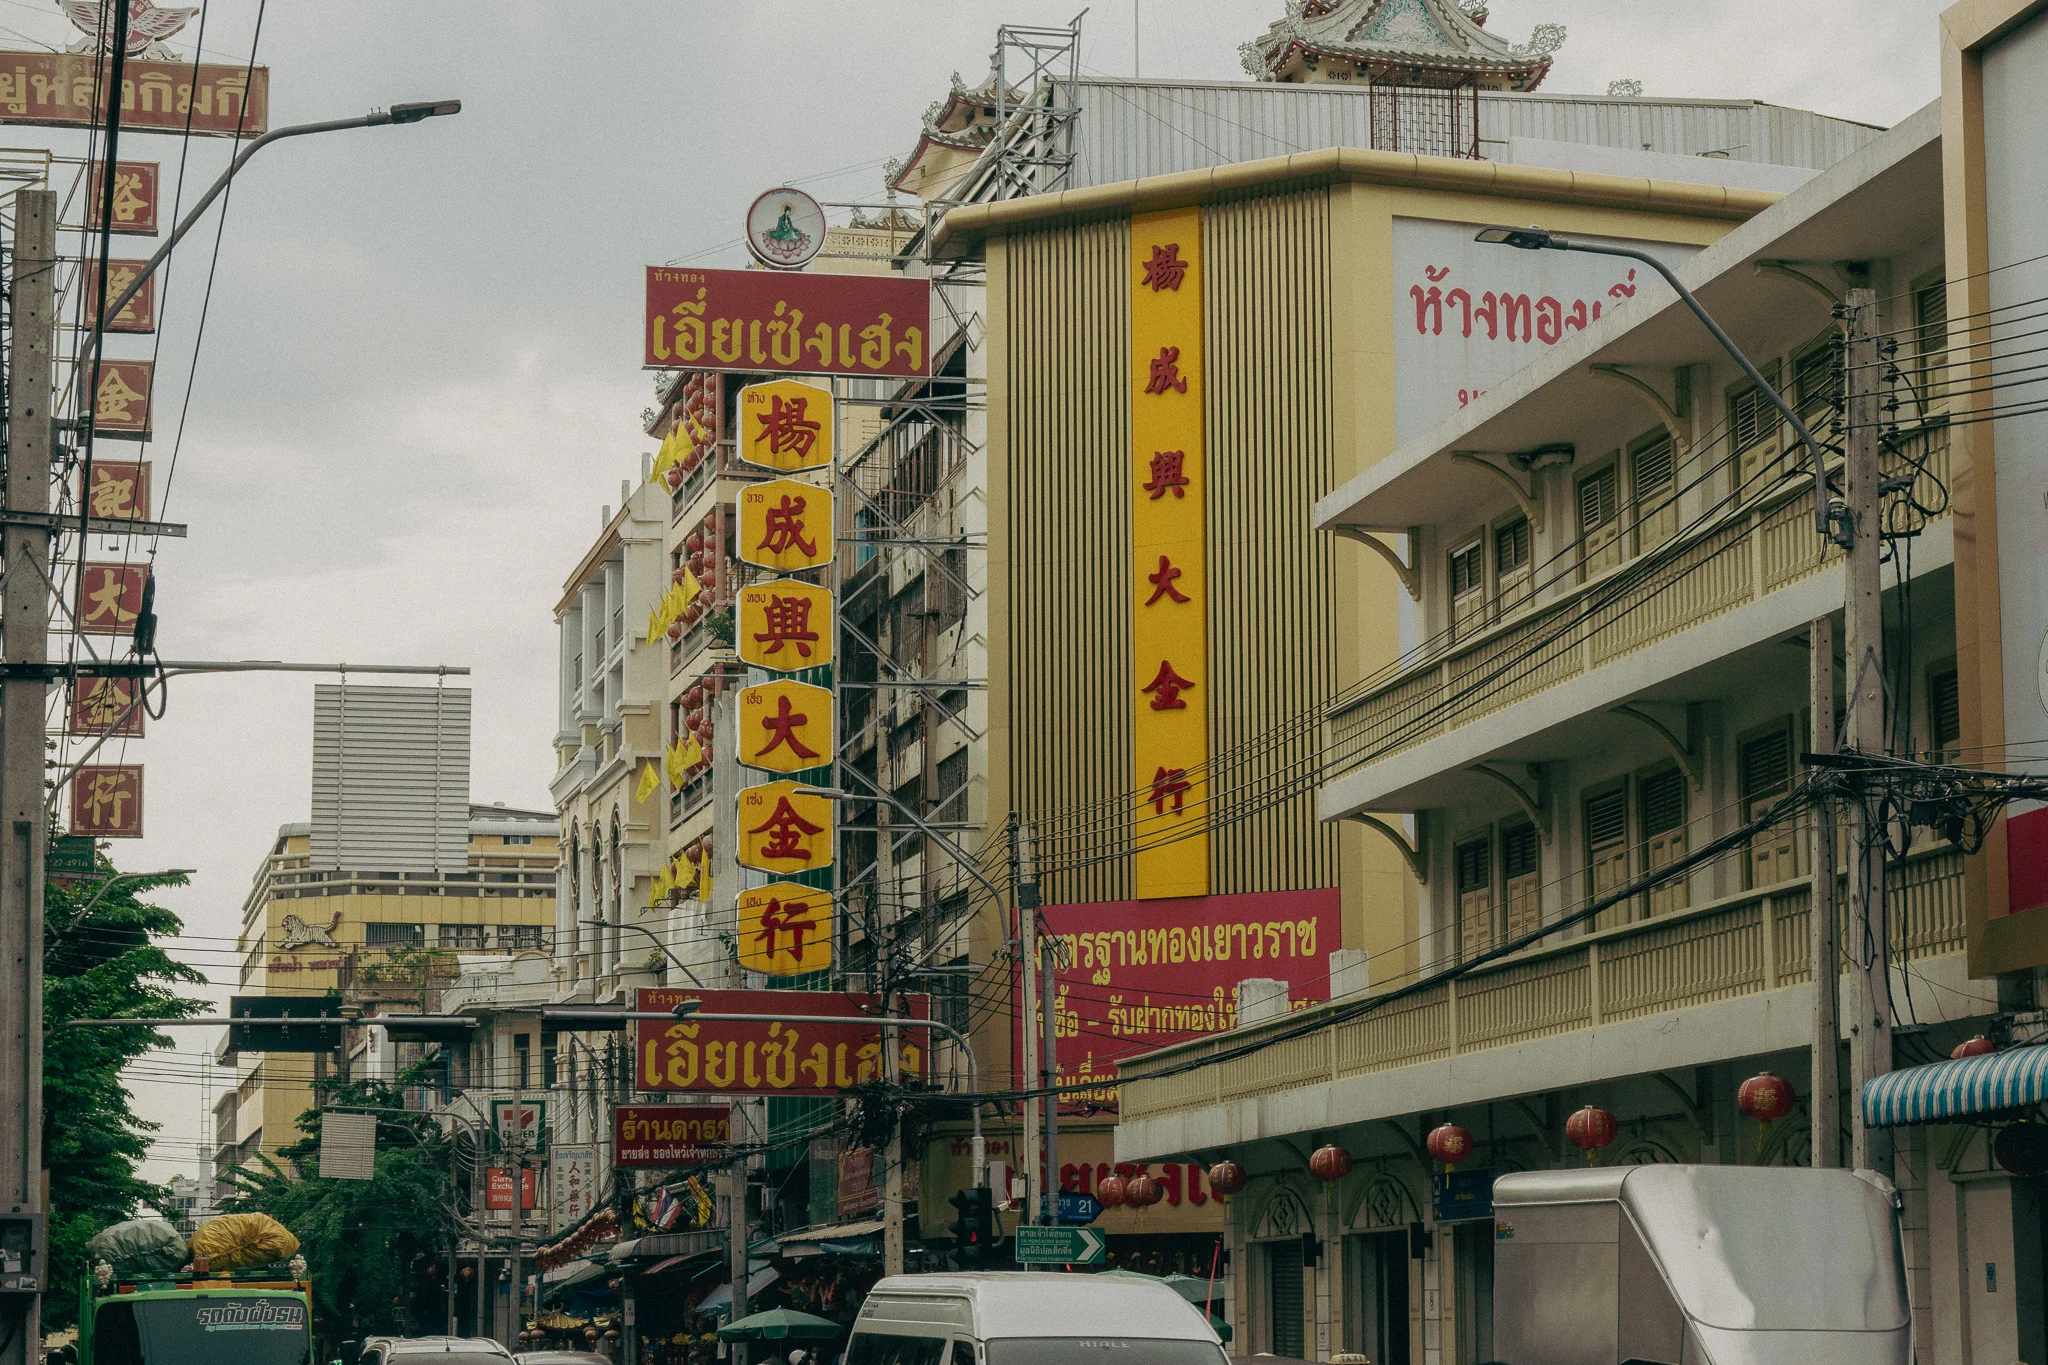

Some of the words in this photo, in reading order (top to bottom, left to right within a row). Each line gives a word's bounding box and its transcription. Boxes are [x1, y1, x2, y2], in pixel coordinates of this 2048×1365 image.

[127, 38, 148, 50] MARK
[654, 269, 706, 283] ห้างทอง
[652, 287, 923, 372] เอี่ยเซ่งเฮง
[1078, 1199, 1092, 1213] 21
